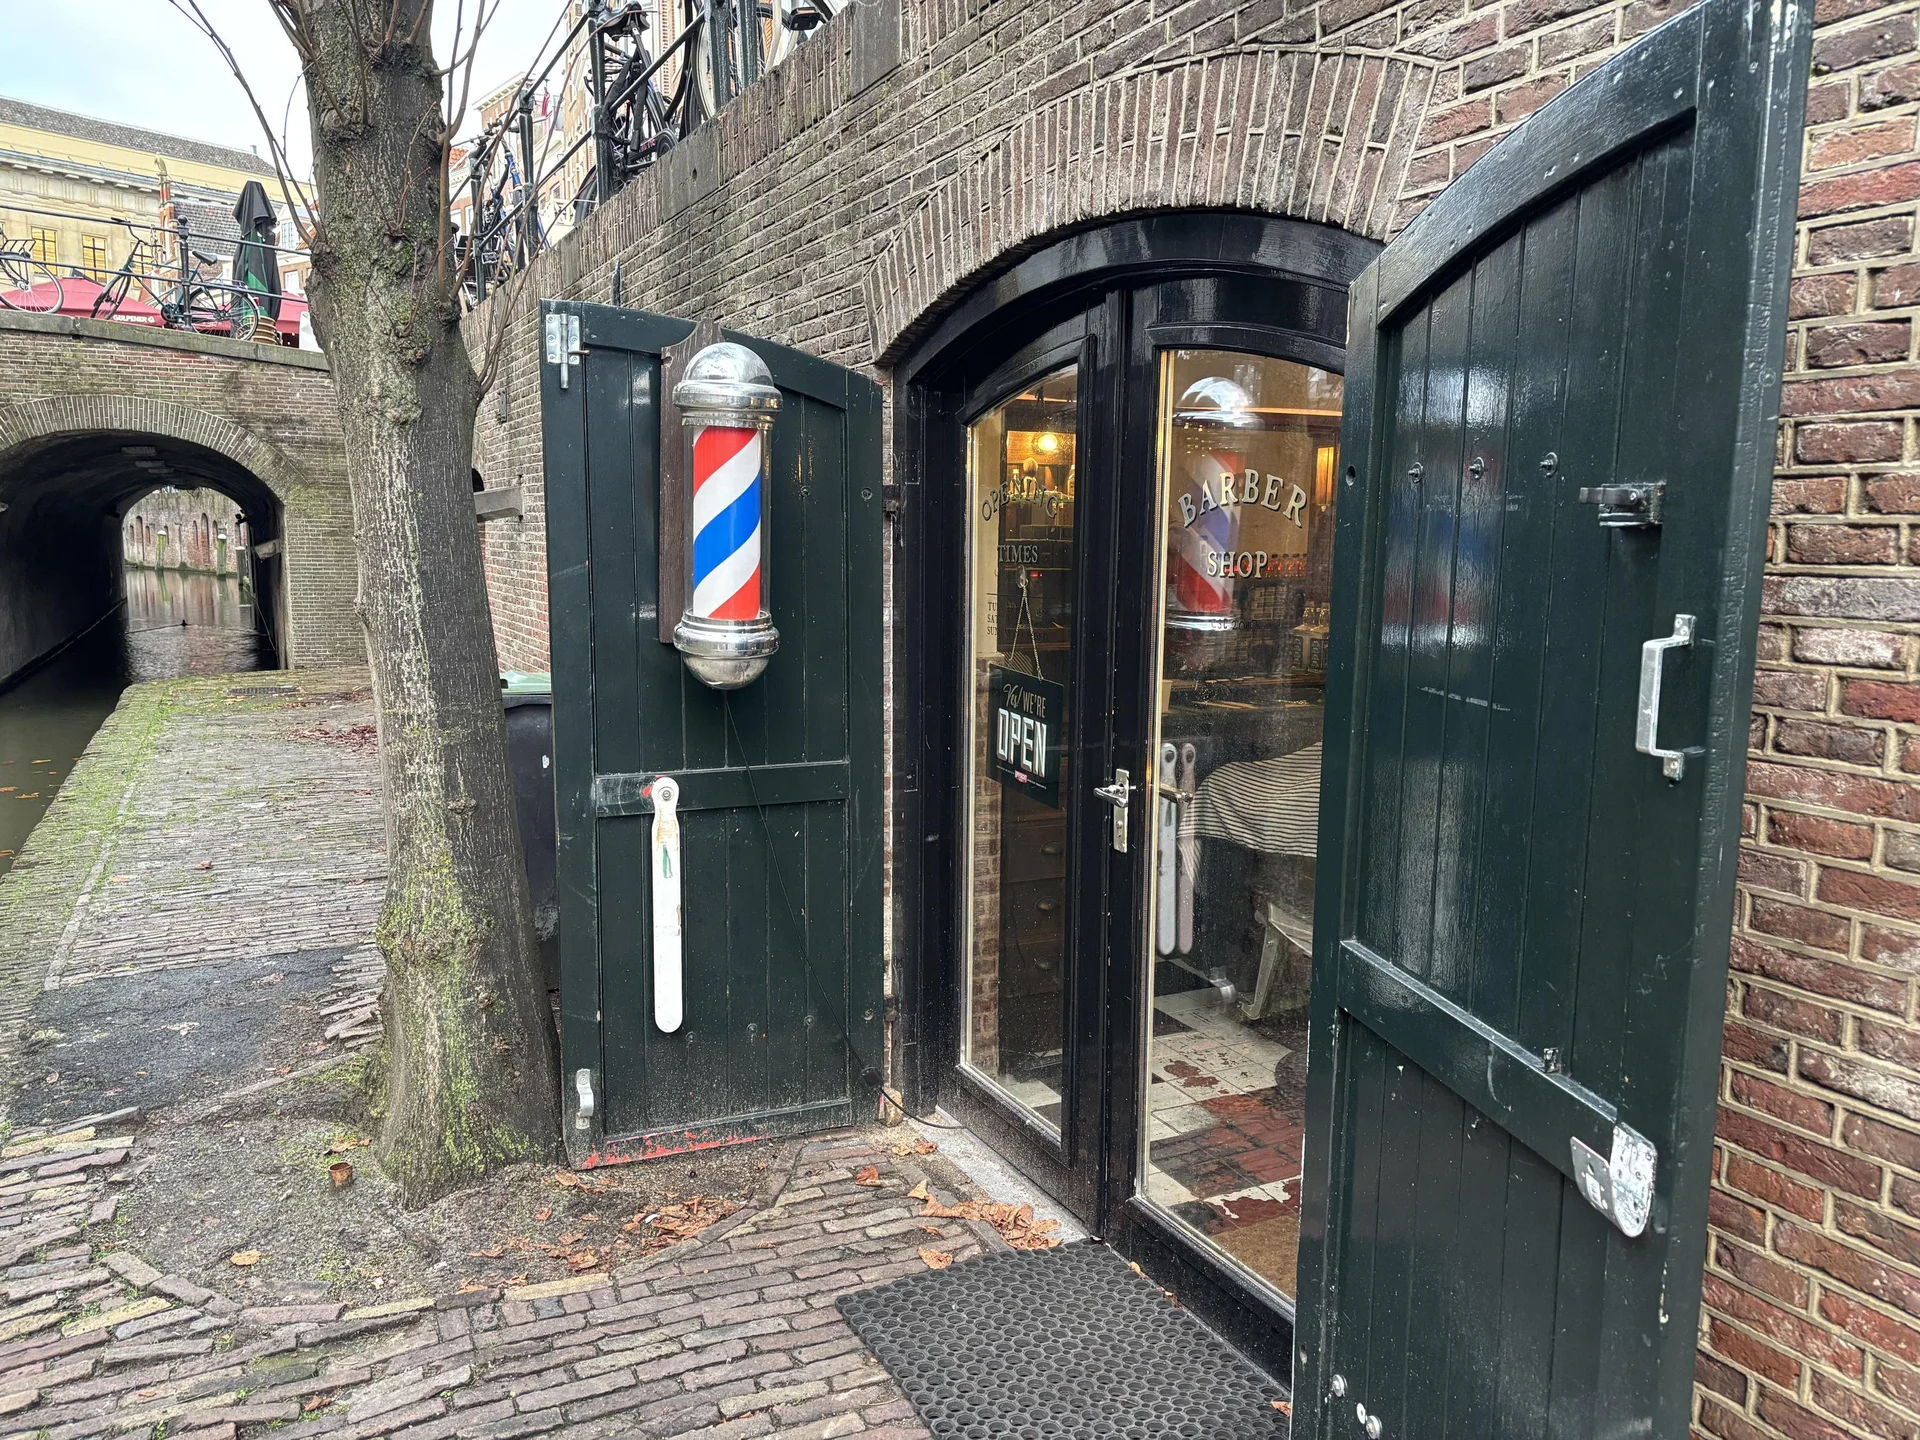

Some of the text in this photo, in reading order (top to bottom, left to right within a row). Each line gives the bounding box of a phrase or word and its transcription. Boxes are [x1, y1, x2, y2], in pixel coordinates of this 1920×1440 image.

[982, 478, 1057, 521] OPENING
[1178, 469, 1307, 528] BARBER
[998, 545, 1038, 563] TIMES
[1207, 551, 1268, 578] SHOP
[1023, 691, 1046, 718] WE'RE
[997, 708, 1047, 778] OPEN
